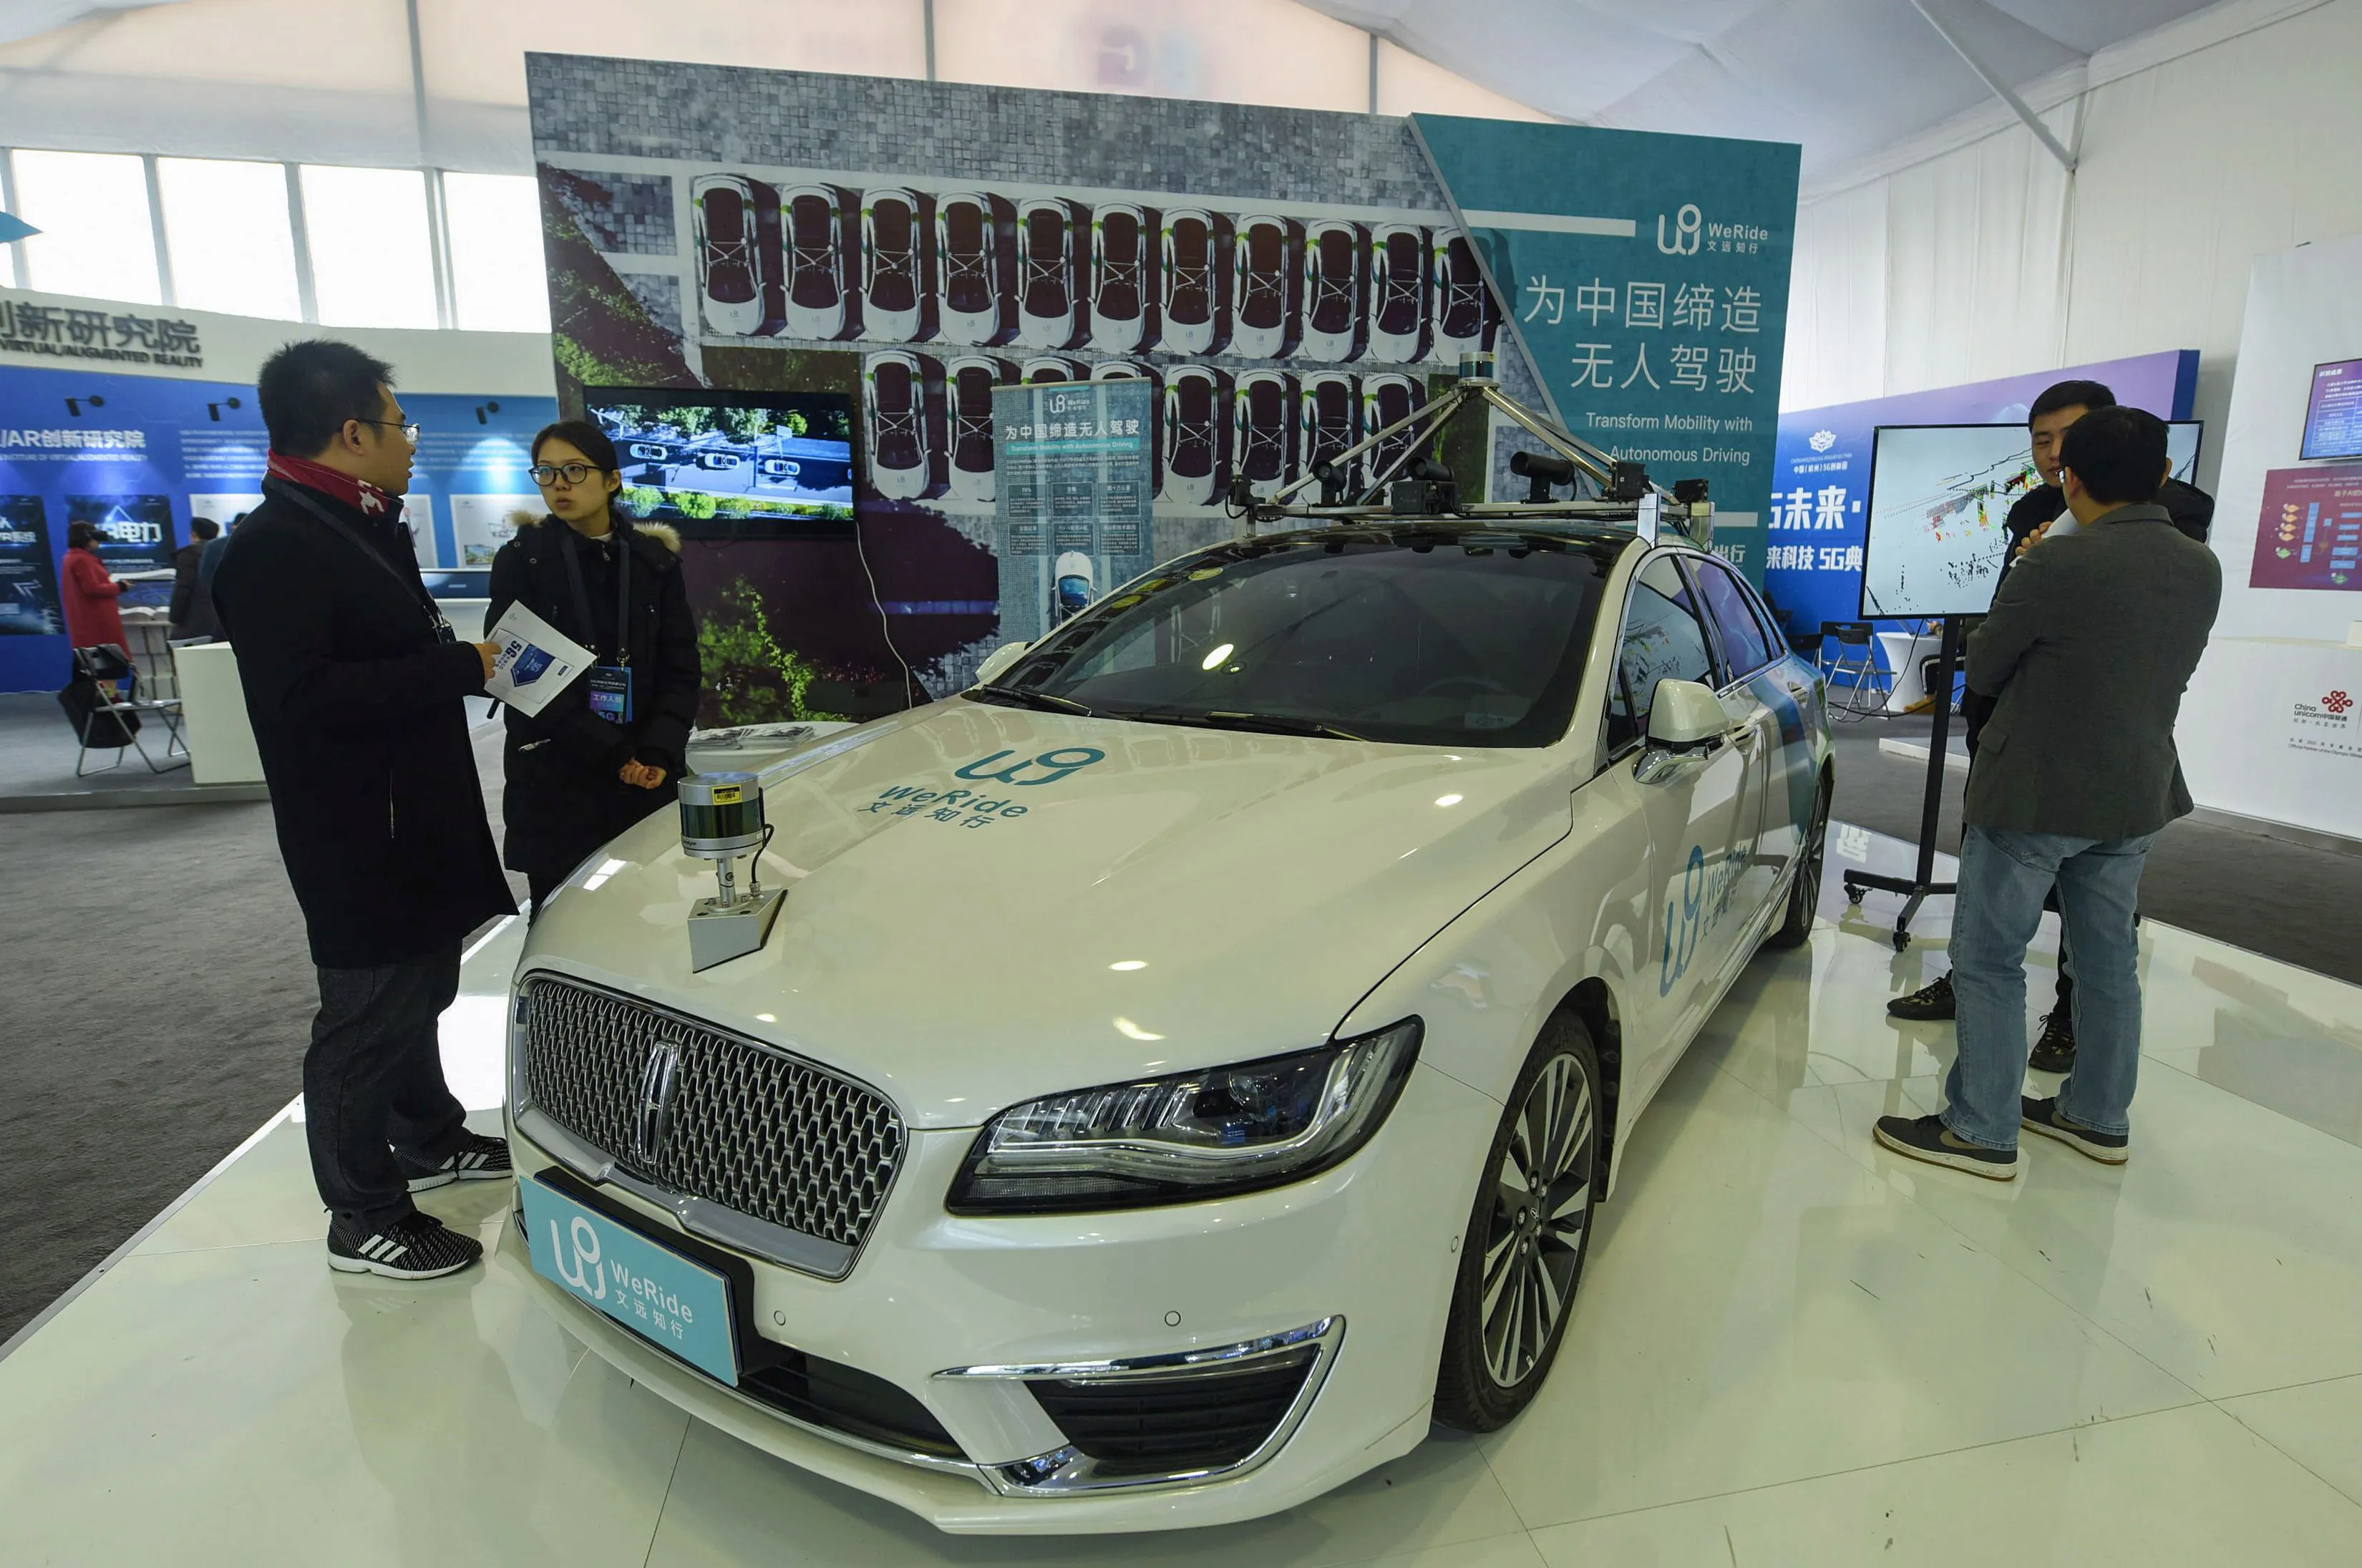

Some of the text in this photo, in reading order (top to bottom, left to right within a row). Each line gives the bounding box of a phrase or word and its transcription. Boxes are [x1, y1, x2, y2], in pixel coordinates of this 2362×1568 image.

[1708, 222, 1768, 240] WeRide
[1707, 240, 1759, 254] 文远知行
[1524, 274, 1762, 333] 为中国缔造
[153, 353, 203, 368] REALITY
[1570, 342, 1757, 394] 无人驾驶
[1005, 419, 1139, 441] 为中国缔造无人驾驶
[1586, 412, 1753, 434] Transform Mobility with
[0, 429, 146, 448] /AR创新研究院
[1112, 440, 1134, 449] Driving
[1610, 444, 1751, 467] Autonomous Driving
[1765, 545, 1862, 572] 来科技 5G典
[505, 640, 523, 659] 5G
[593, 693, 623, 703] 工作人员
[2294, 703, 2317, 712] China
[2294, 710, 2322, 719] unicom
[878, 786, 1029, 818] WeRide
[857, 800, 995, 829] 文远知行
[611, 1259, 694, 1324] WeRide
[615, 1288, 684, 1340] 文远知行
